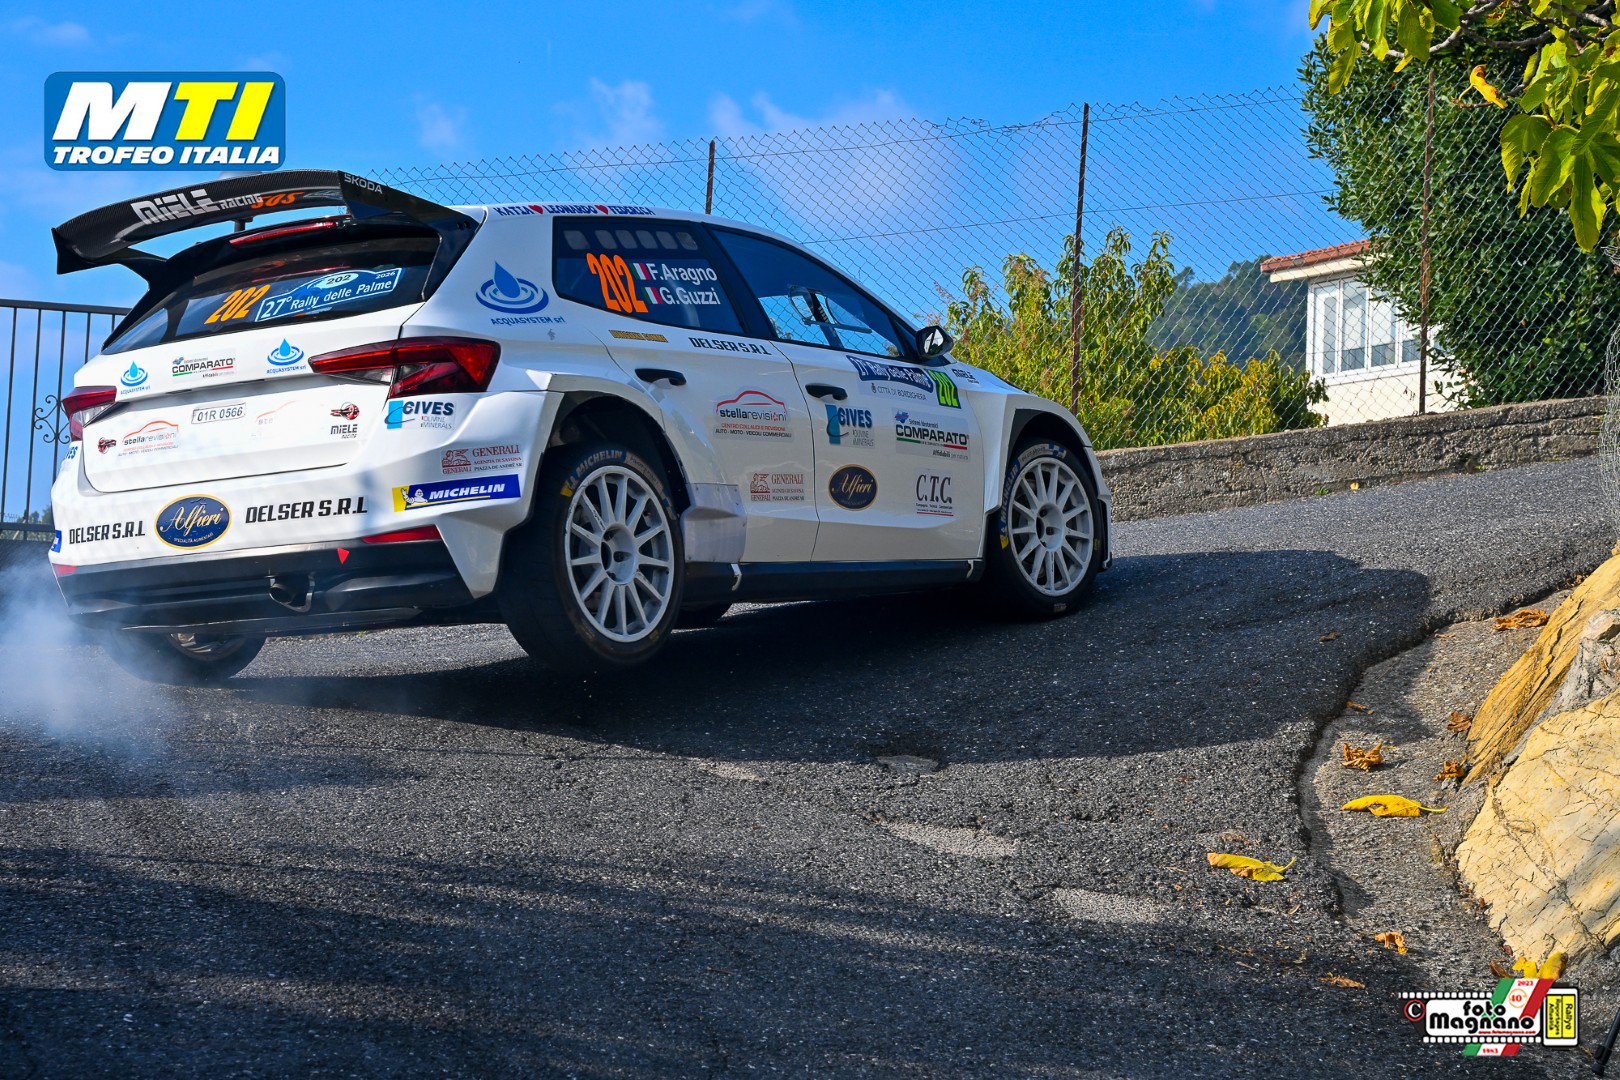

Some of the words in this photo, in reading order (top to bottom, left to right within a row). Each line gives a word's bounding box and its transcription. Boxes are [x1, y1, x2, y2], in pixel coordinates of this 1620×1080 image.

[493, 205, 534, 216] KATIA
[542, 205, 599, 215] LEONARDO
[607, 205, 656, 216] FEDERICA
[325, 274, 352, 285] 202
[586, 252, 648, 314] 202
[648, 263, 717, 285] F.Aragno
[203, 284, 271, 324] 202
[290, 295, 320, 311] Rally
[323, 287, 351, 302] delle
[356, 279, 392, 295] Palme
[659, 287, 721, 305] G.Guzzi
[491, 316, 553, 325] ACQUASYSTEM
[688, 337, 738, 352] DELSER
[172, 358, 234, 374] COMPARATO
[266, 365, 299, 374] ACQUASYSTEM
[928, 369, 959, 407] 202
[196, 409, 217, 423] 01R
[218, 405, 243, 419] 0566
[402, 401, 454, 415] CIVES
[838, 407, 872, 428] CIVES
[895, 424, 967, 446] COMPARATO
[472, 445, 520, 458] GENERALI
[442, 466, 472, 475] GENERALI
[575, 449, 622, 477] MICHELIN
[771, 473, 804, 485] GENERALI
[831, 473, 874, 500] Alfieri
[429, 483, 505, 500] MICHELIN
[245, 500, 313, 524] DELSER
[159, 506, 225, 537] Alfieri
[69, 524, 110, 545] DELSER
